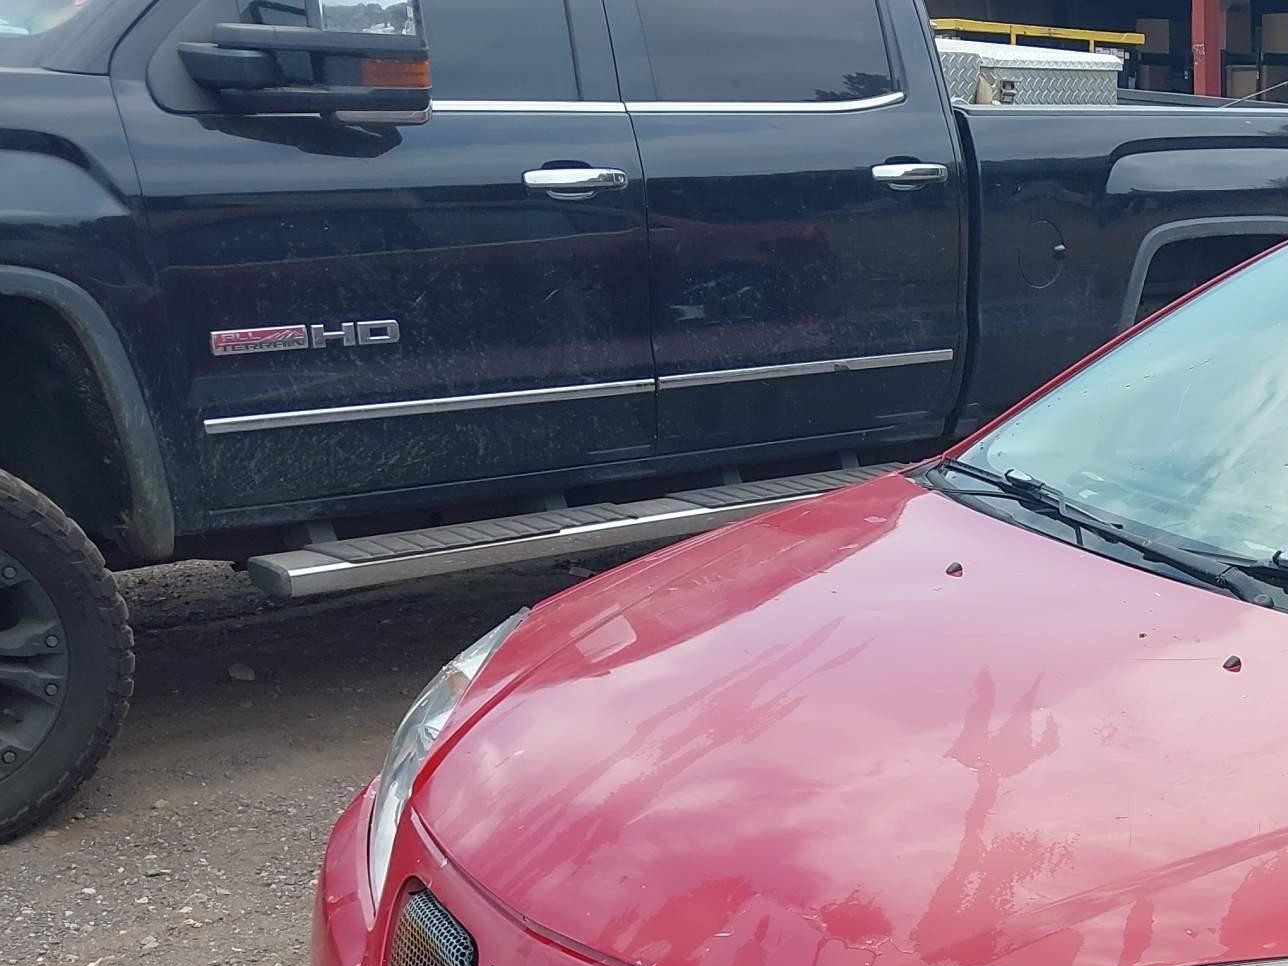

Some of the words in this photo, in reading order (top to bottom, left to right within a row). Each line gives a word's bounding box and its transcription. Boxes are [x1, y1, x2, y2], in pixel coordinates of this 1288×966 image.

[221, 332, 262, 342] ALL
[311, 320, 400, 348] HD
[217, 340, 304, 353] TERRAIN
